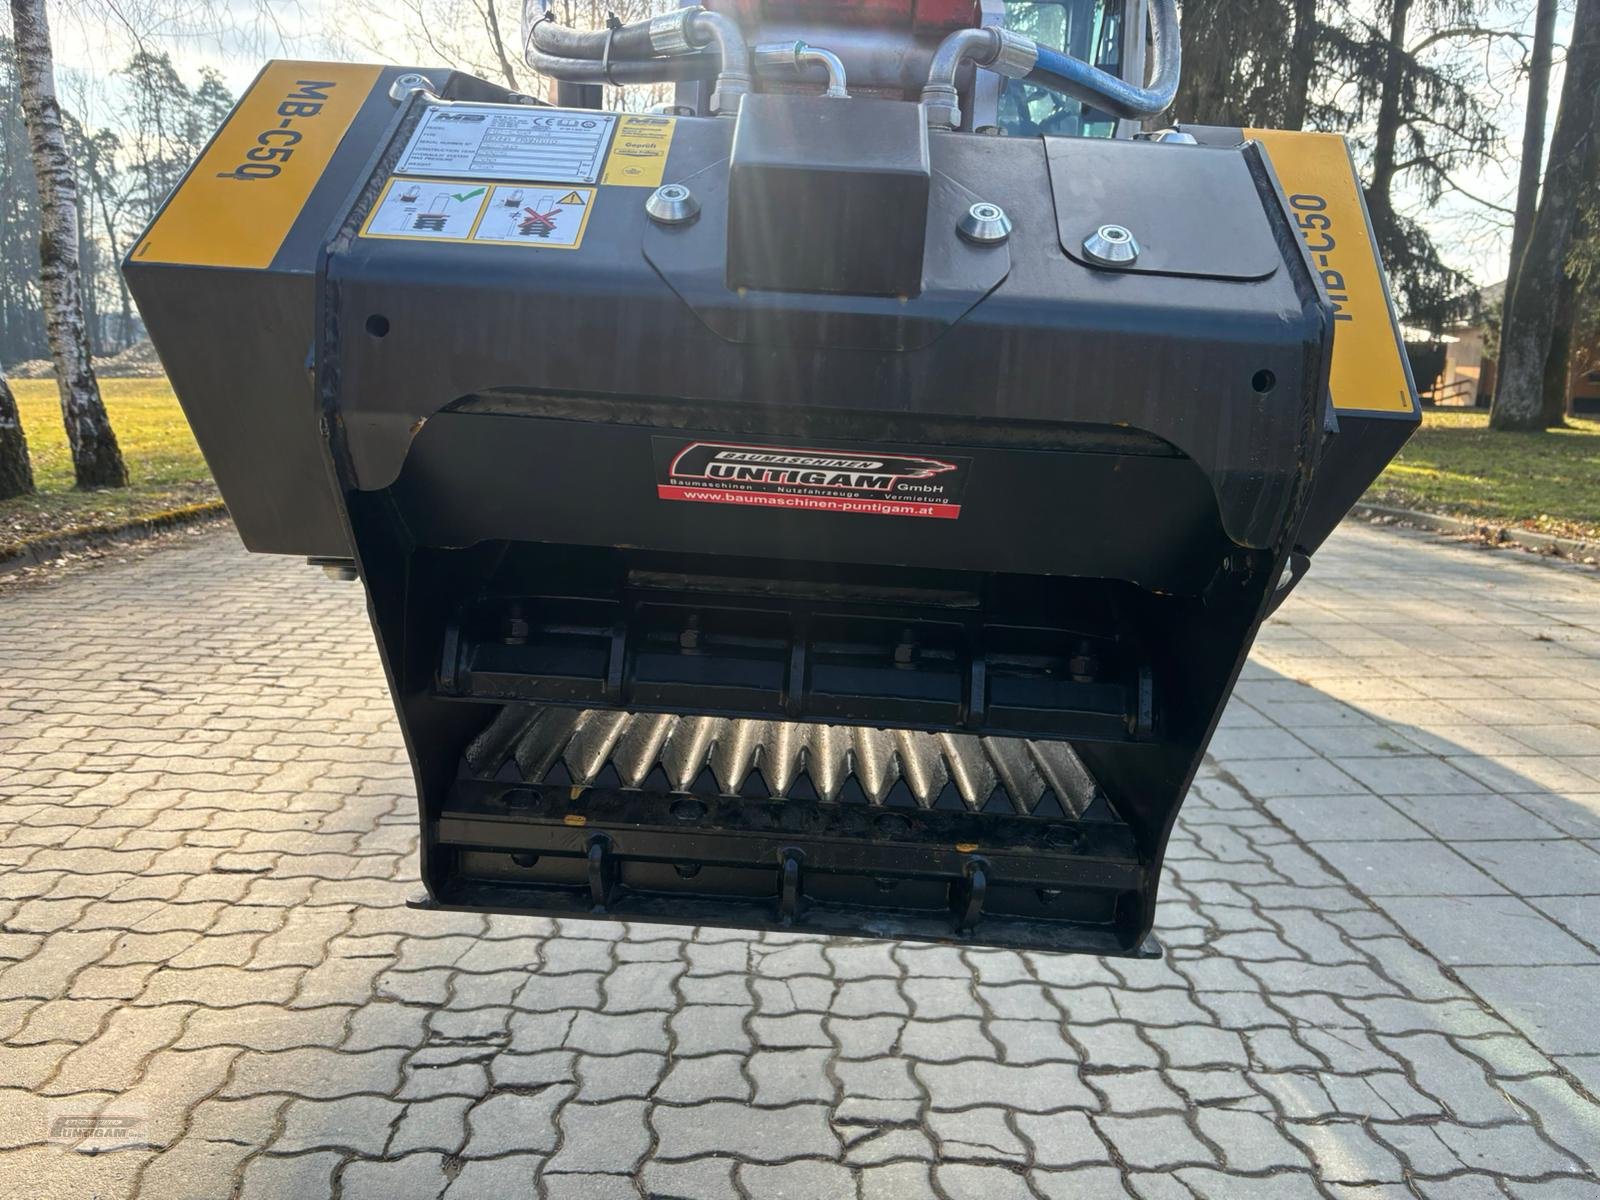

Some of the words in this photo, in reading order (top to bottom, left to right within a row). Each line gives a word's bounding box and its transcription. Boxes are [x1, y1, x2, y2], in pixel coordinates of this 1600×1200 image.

[722, 451, 874, 470] BAUMASCHINEN
[670, 478, 753, 491] Baumaschinen
[777, 486, 860, 499] Nutzfahrzeuge
[884, 493, 950, 505] Vermietung
[896, 482, 944, 494] GmbH
[684, 491, 934, 516] www.baumaschinen-puntigam.at
